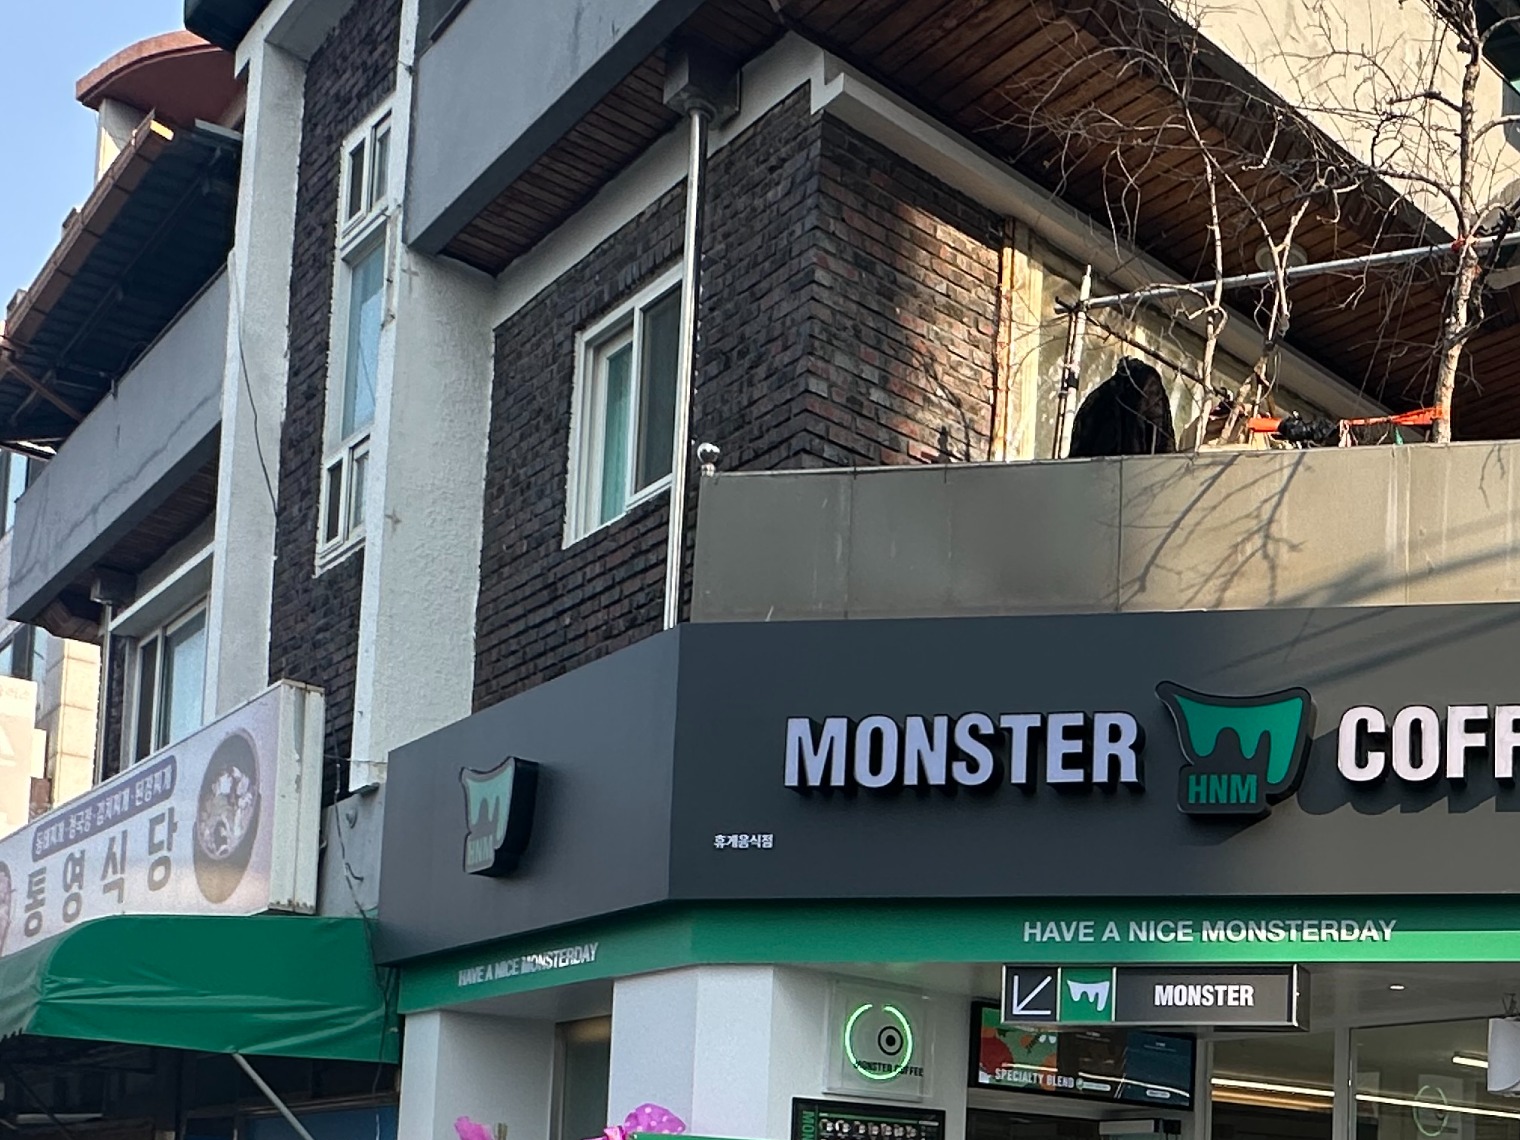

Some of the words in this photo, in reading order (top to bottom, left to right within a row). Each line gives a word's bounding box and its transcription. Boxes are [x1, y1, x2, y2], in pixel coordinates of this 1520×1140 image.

[784, 710, 1143, 790] MONSTER
[1188, 773, 1258, 805] HNM
[713, 834, 774, 849] 휴게음식점
[24, 806, 178, 938] 통영식당
[1023, 921, 1095, 943] HAVE
[1102, 921, 1122, 942] A
[1129, 921, 1194, 942] NICE
[1201, 919, 1398, 943] MONSTERDAY
[458, 967, 484, 987] HAVE
[485, 963, 493, 980] A
[495, 957, 521, 980] NICE
[521, 942, 599, 975] MONSTERDAY
[1154, 983, 1255, 1007] MONSTER
[994, 1067, 1044, 1085] SPECIALTY
[1046, 1072, 1075, 1088] BLEND
